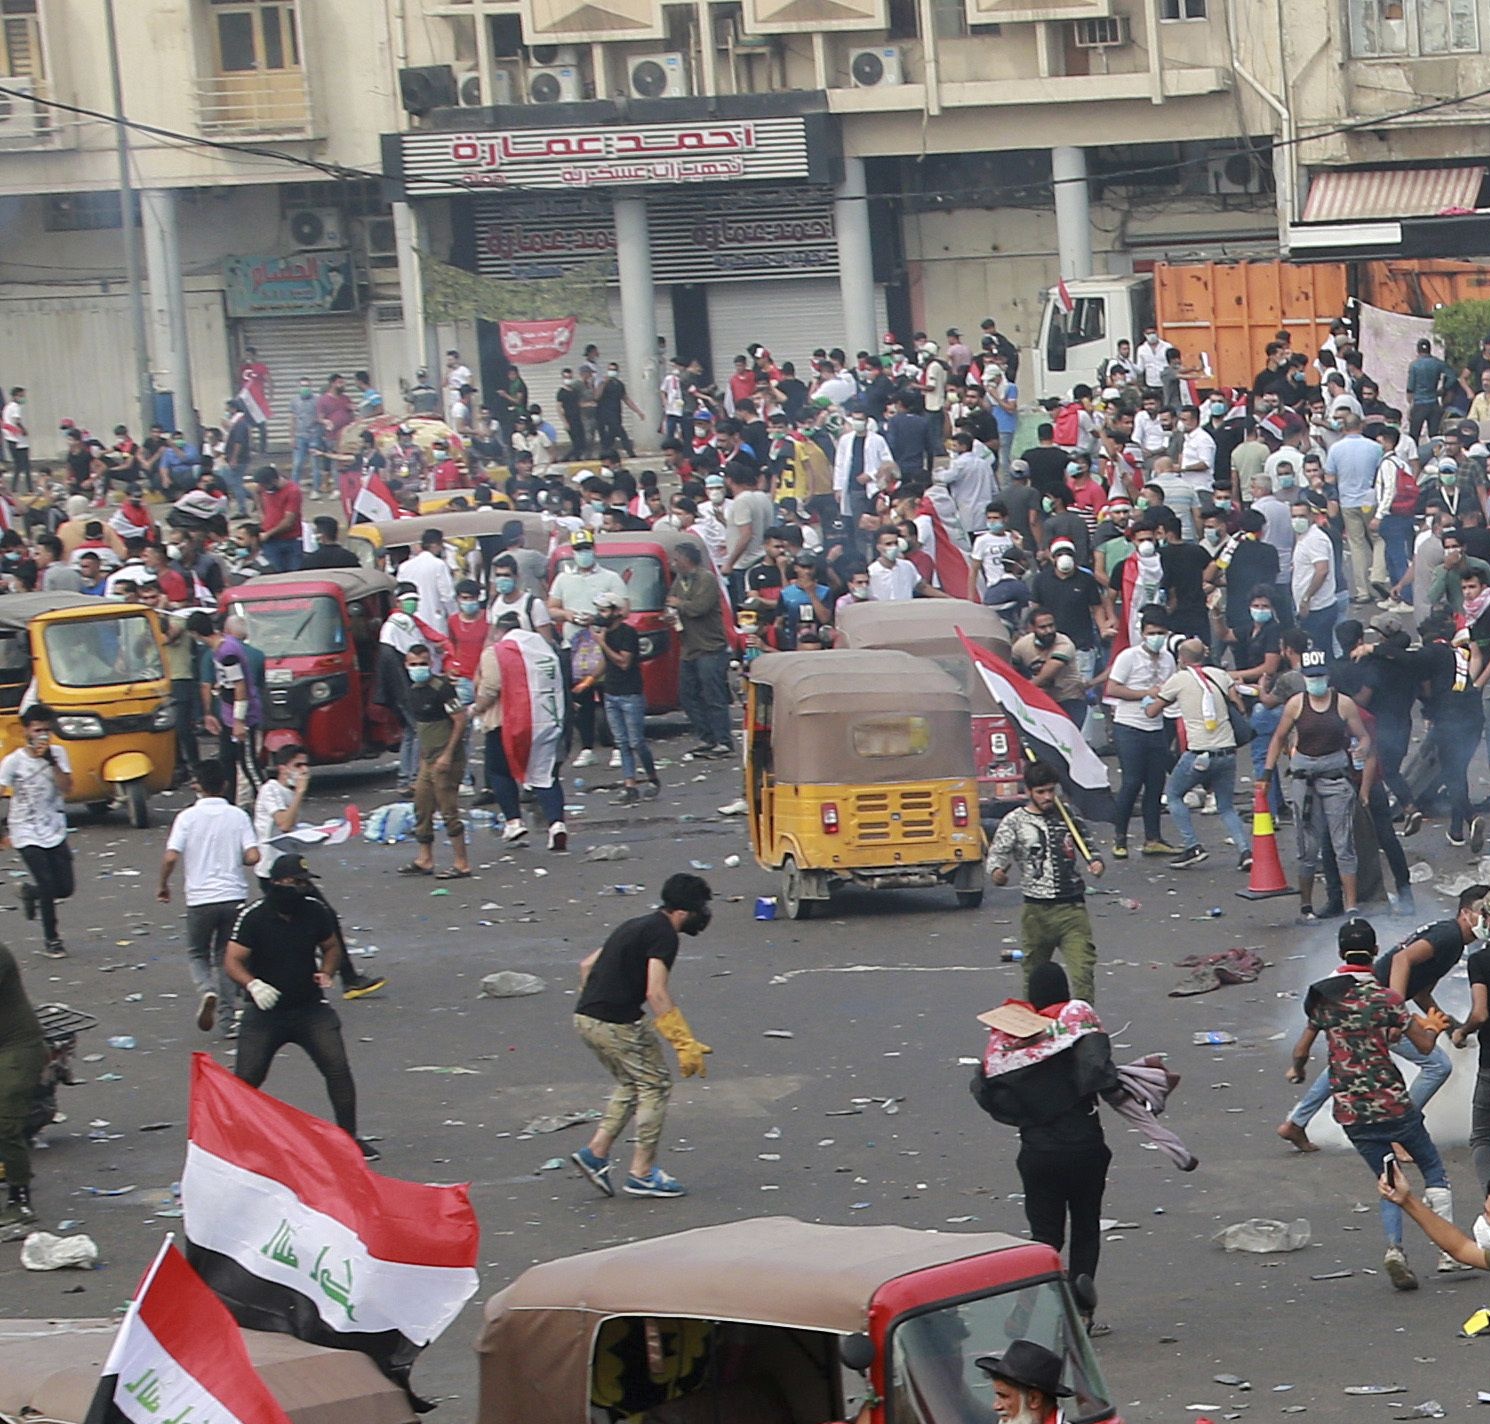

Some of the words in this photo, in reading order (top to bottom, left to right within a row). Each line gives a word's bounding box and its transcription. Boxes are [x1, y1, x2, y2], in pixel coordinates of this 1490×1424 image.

[451, 133, 606, 166] عمارة
[616, 123, 756, 152] احمد
[560, 163, 648, 187] عسكرية
[649, 156, 744, 182] تجهيزات
[1302, 651, 1325, 667] BOY
